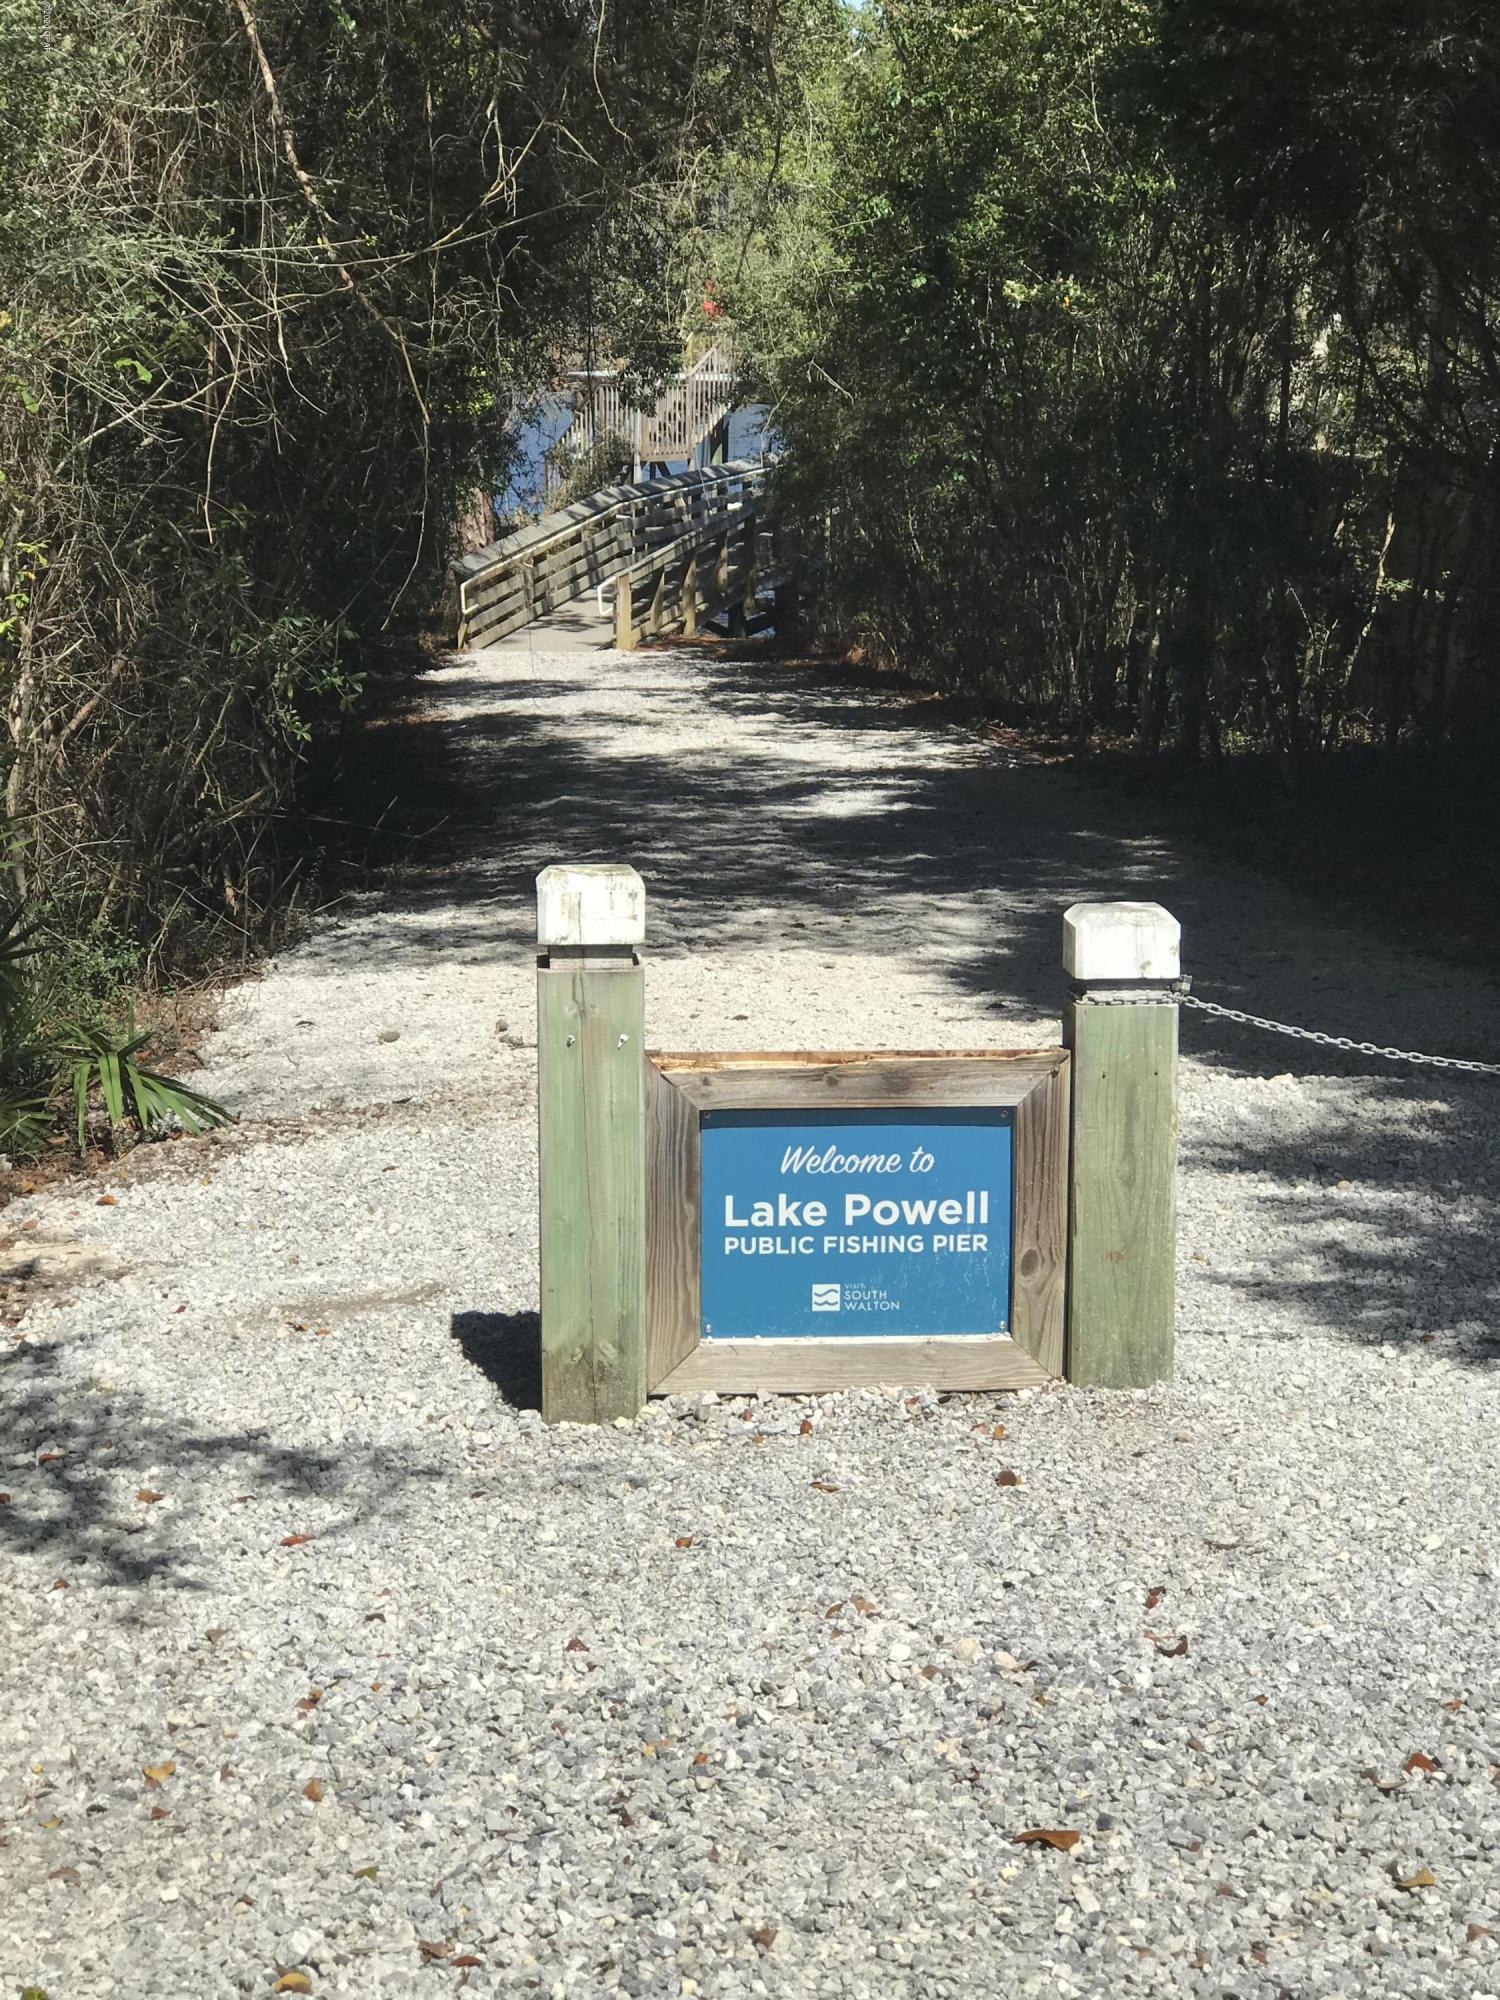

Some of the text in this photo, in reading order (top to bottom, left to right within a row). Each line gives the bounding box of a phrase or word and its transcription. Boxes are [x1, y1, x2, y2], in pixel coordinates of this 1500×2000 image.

[780, 1145, 935, 1174] Welcome to
[724, 1191, 989, 1227] Lake Powell
[724, 1234, 988, 1255] PUBLIC FISHING PIER
[844, 1290, 887, 1301] SOUTH
[844, 1301, 900, 1312] WALTON
